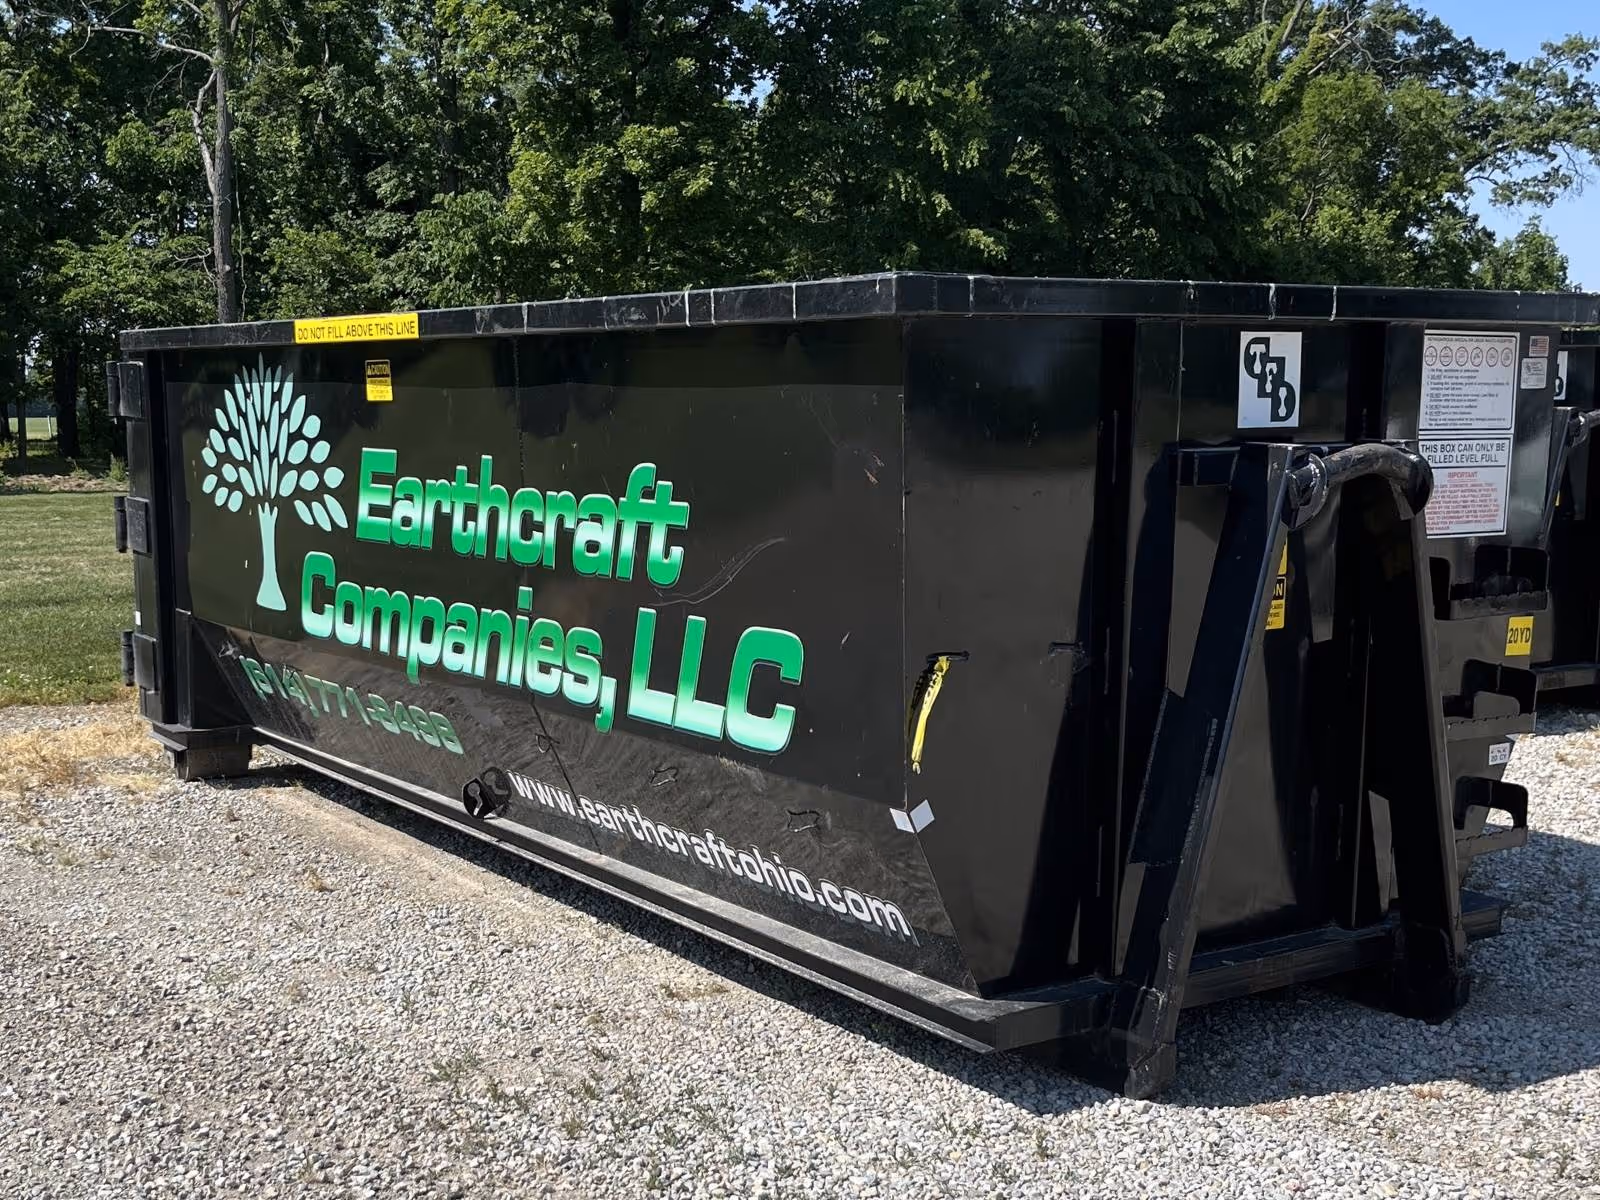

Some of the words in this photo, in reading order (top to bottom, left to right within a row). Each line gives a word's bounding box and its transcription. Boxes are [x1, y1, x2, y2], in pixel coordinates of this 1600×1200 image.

[298, 328, 308, 340] DO
[310, 327, 325, 339] NOT
[328, 326, 343, 338] FILL
[346, 324, 373, 337] ABOVE
[375, 322, 394, 336] THIS
[396, 321, 415, 335] LINE
[1421, 444, 1438, 453] THIS
[1440, 444, 1456, 453] BOX
[1458, 443, 1474, 452] CAN
[1475, 443, 1495, 452] ONLY
[1496, 443, 1505, 451] BE
[1428, 455, 1454, 463] FILLED
[1456, 454, 1479, 463] LEVEL
[1481, 454, 1499, 462] FULL
[355, 447, 689, 588] Earthcraft
[301, 551, 617, 733] Companies,
[627, 607, 804, 754] LLC
[507, 770, 911, 937] www.earthcraftohio.com
